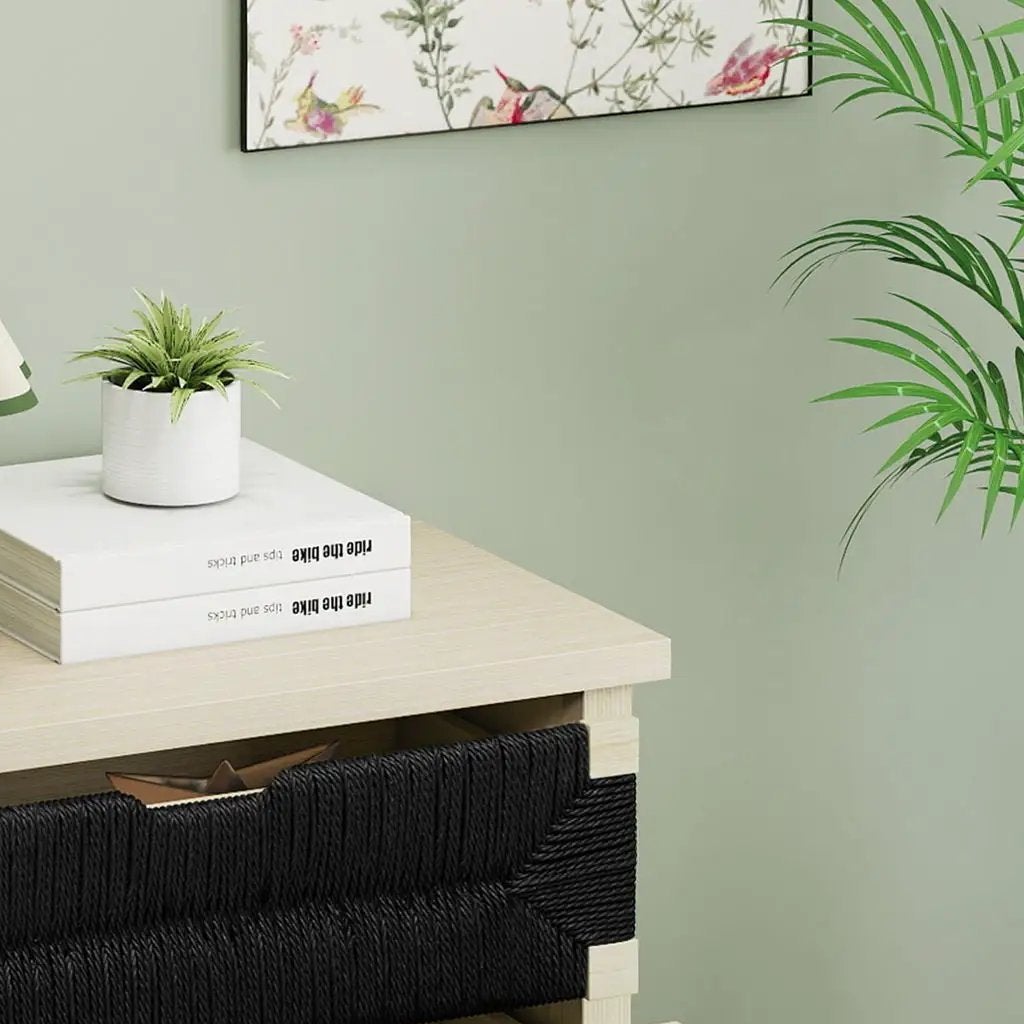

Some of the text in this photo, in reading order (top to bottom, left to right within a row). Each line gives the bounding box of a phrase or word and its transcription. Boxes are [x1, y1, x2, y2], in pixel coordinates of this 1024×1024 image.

[207, 539, 372, 569] ride the bike tips and tricks
[207, 591, 372, 622] ride the bike tips and tricks
